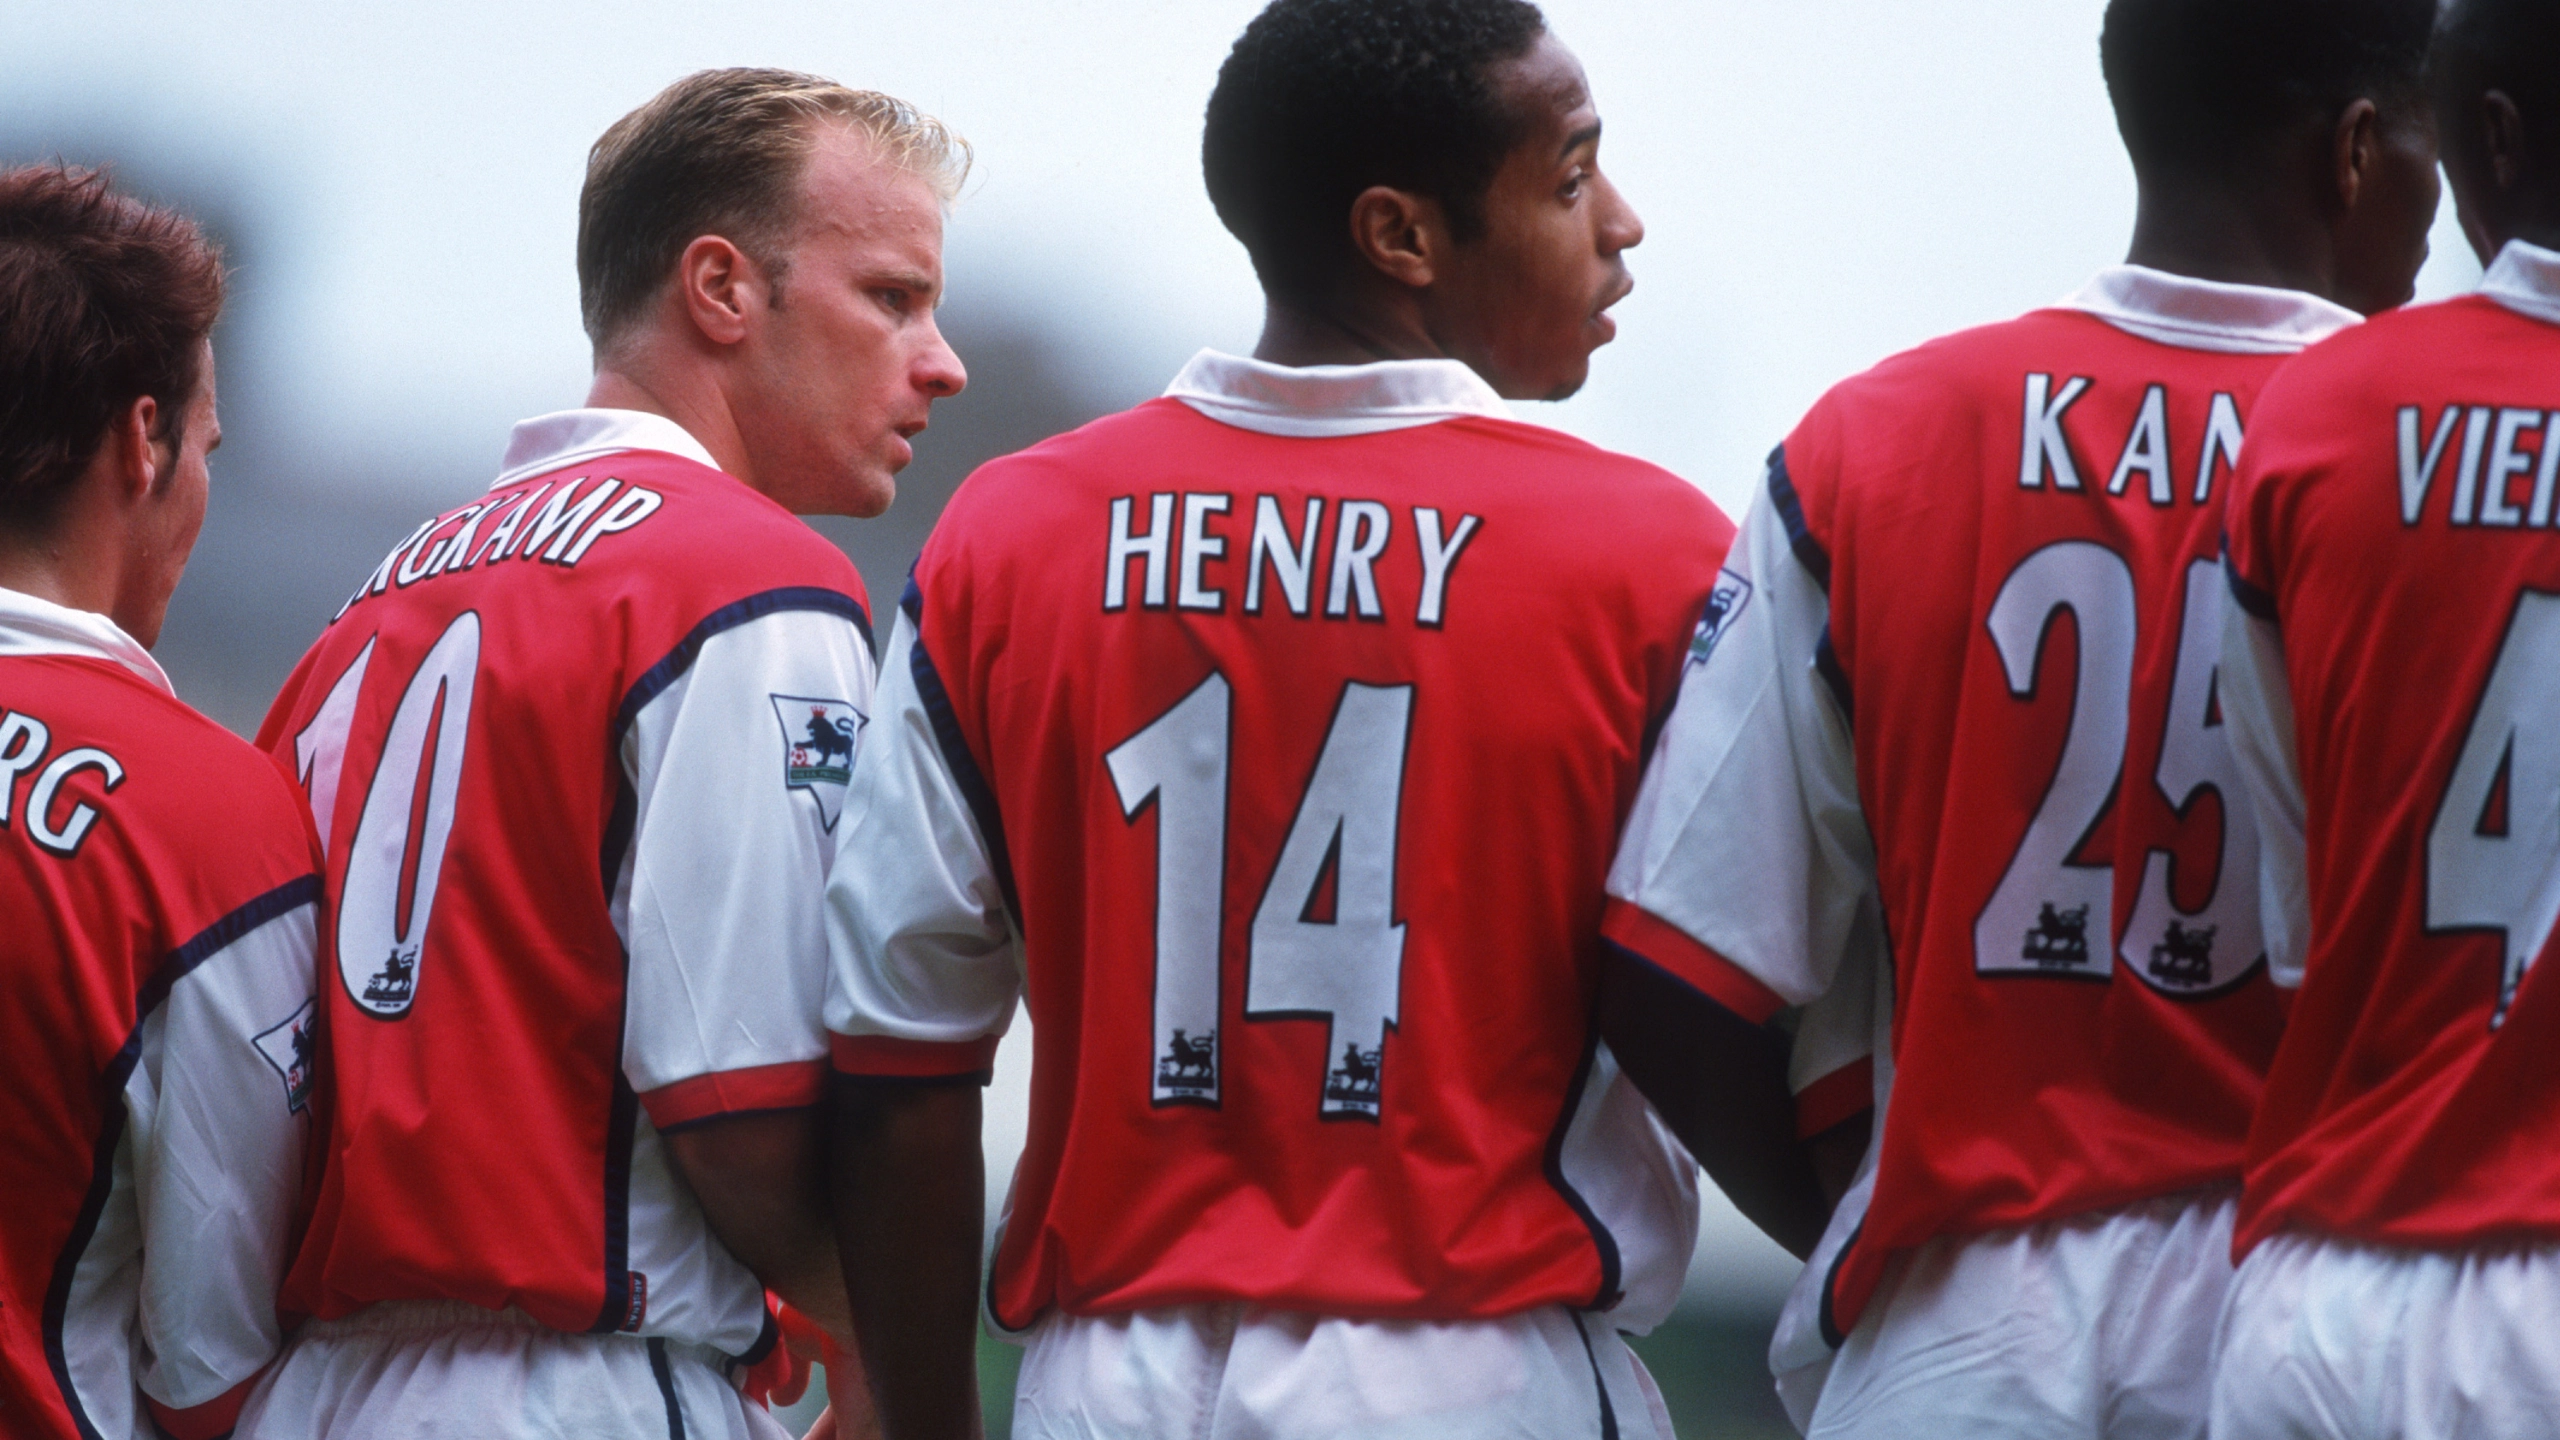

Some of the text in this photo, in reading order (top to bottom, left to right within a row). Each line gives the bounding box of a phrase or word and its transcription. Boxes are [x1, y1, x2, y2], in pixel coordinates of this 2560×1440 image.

[330, 476, 662, 625] RGKAMP
[1102, 492, 1484, 631] HENRY
[2397, 404, 2560, 529] VIEI
[0, 705, 127, 861] RG
[294, 608, 482, 1021] 10
[1104, 670, 1416, 1125] 14
[1974, 538, 2267, 995] 25
[2424, 586, 2560, 1032] 4
